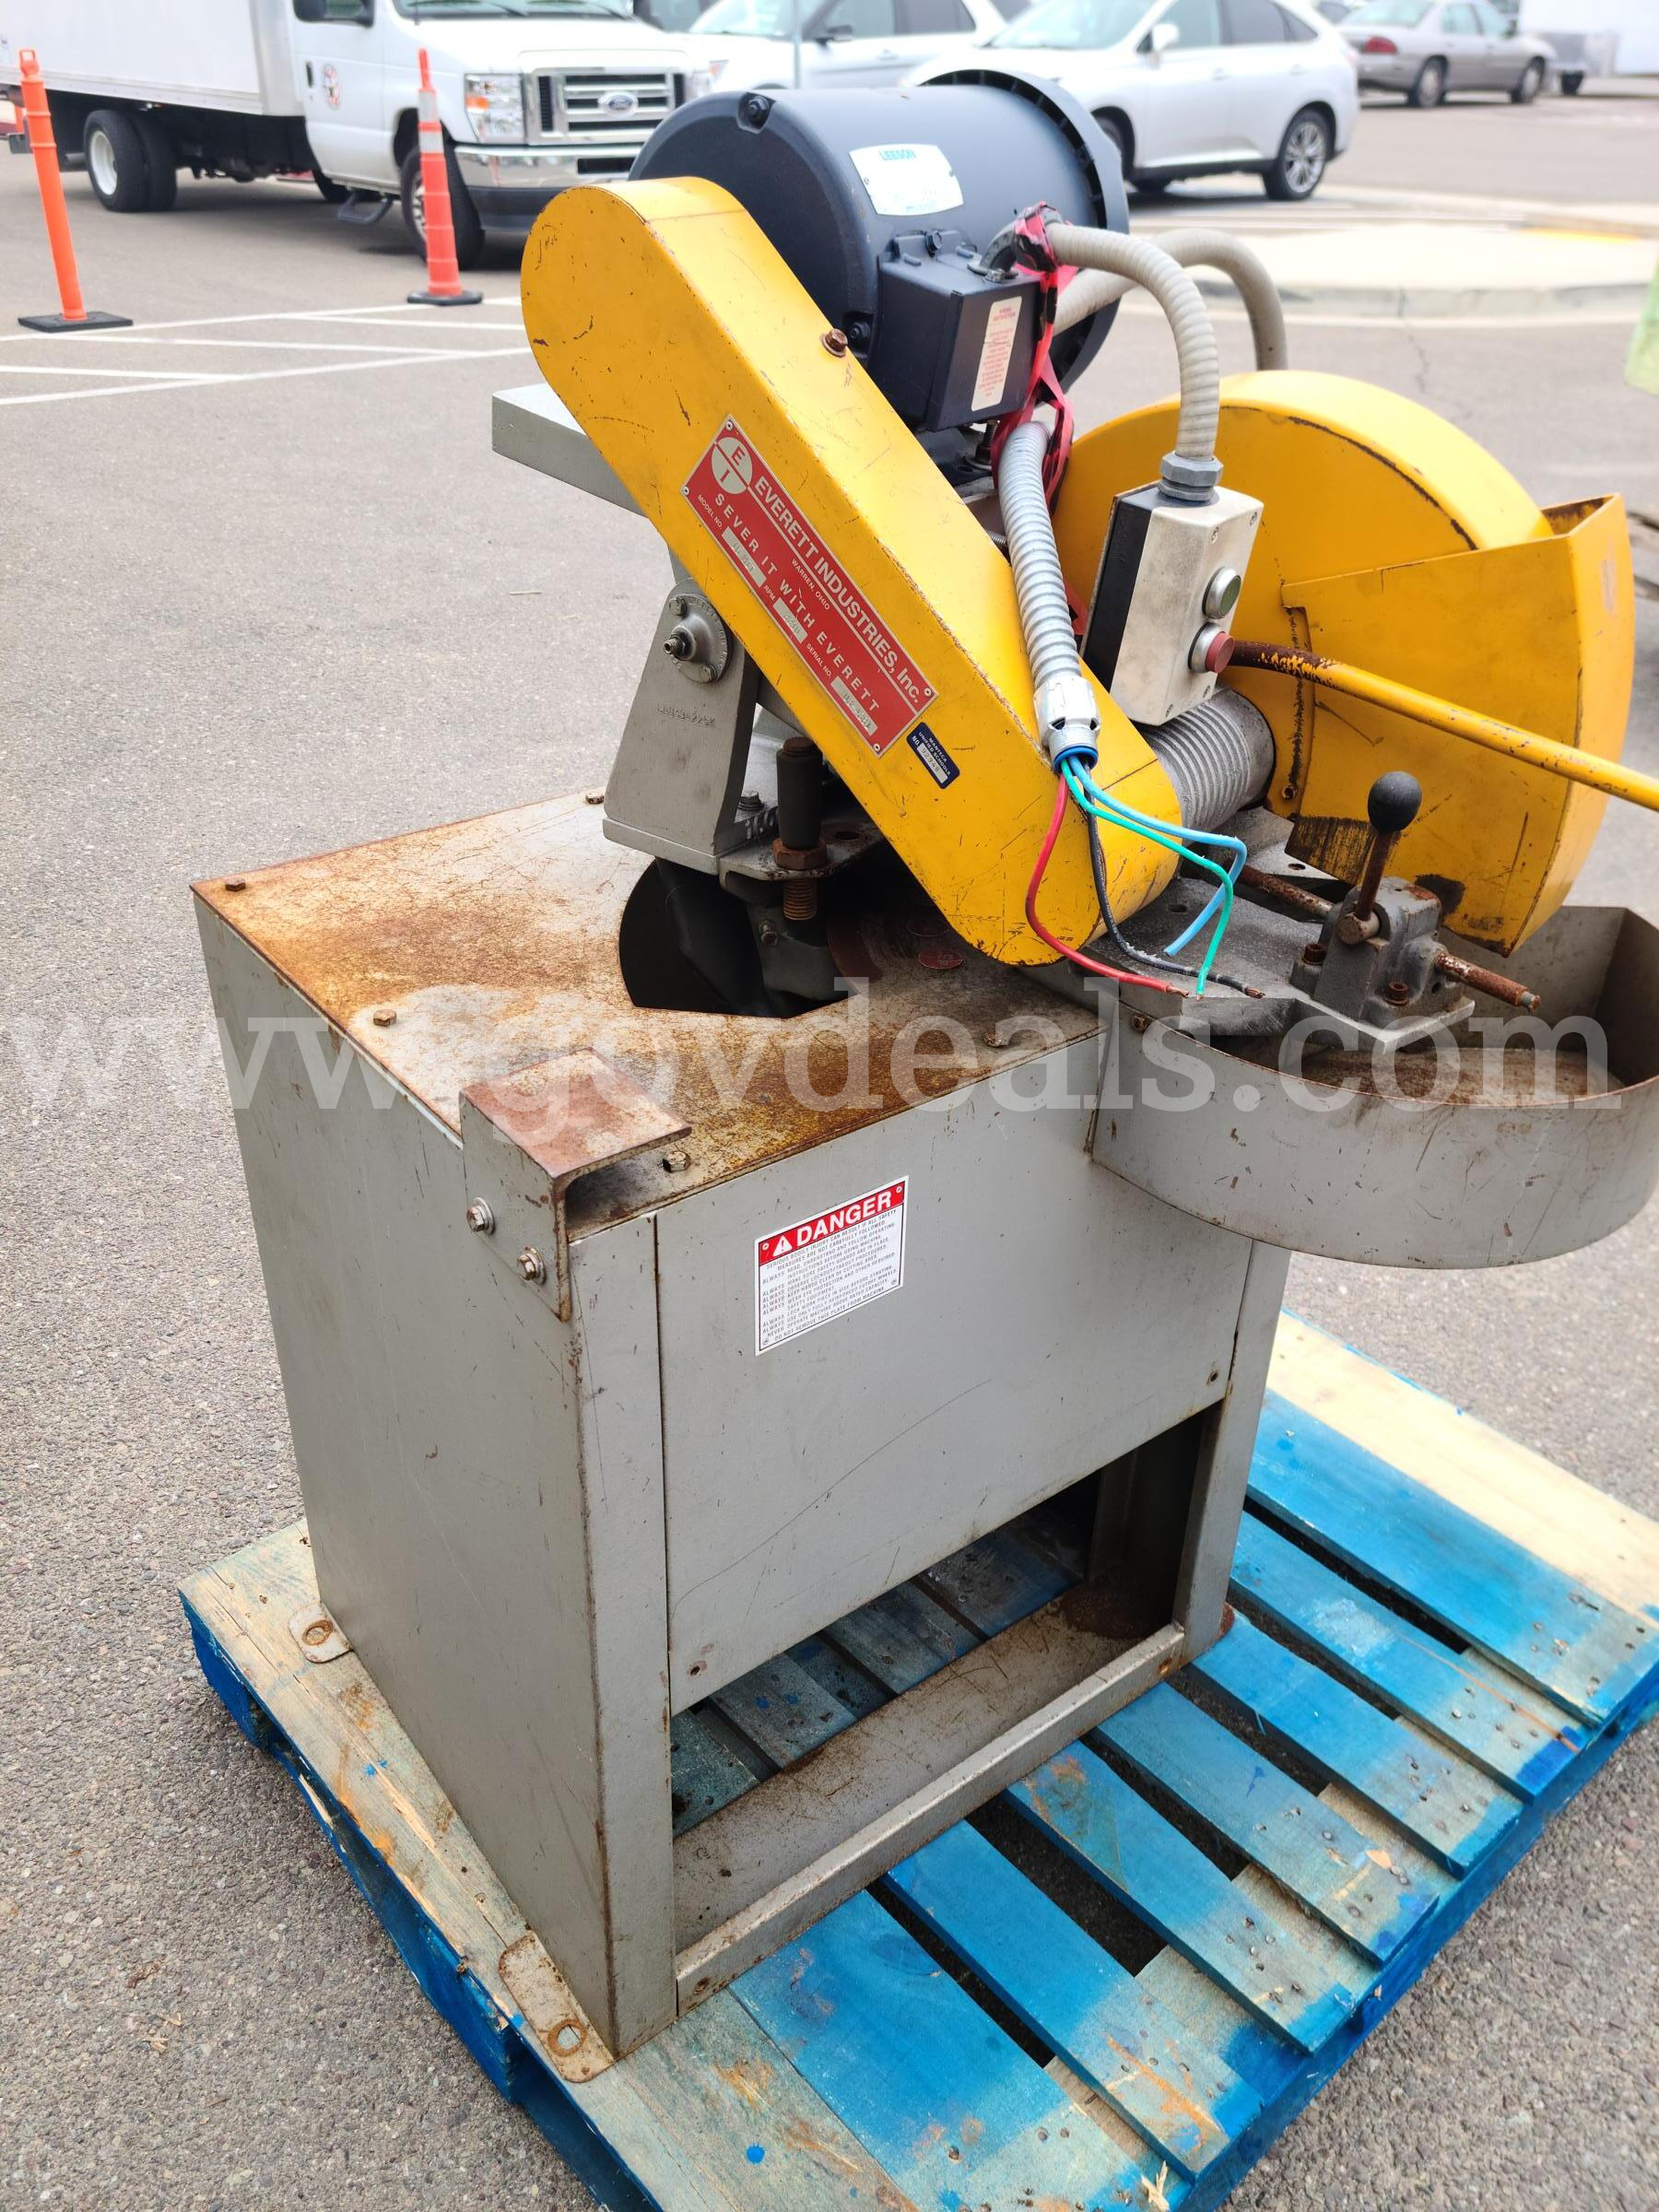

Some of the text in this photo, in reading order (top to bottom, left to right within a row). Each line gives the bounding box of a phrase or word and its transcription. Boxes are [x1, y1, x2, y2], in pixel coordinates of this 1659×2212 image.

[877, 148, 916, 161] LEESON
[730, 444, 746, 465] E
[719, 467, 730, 484] I
[697, 492, 715, 518] MODEL
[712, 513, 724, 530] NO.
[762, 583, 776, 602] RPM
[805, 641, 824, 666] SERIAL
[821, 664, 833, 679] NO.
[753, 474, 925, 704] EVERETT INDUSTRIES, Inc.
[790, 558, 830, 611] WARREN, OHIO
[713, 490, 879, 714] SEVER IT WITH EVERETT
[918, 731, 951, 775] UNIFIED SCHOOLS
[928, 736, 947, 762] MANTECA
[796, 1189, 891, 1246] DANGER
[878, 1208, 896, 1220] SAFETY
[818, 1244, 827, 1253] NOT
[762, 1269, 784, 1284] ALWAYS
[762, 1282, 784, 1297] ALWAYS
[762, 1288, 784, 1303] ALWAYS
[762, 1295, 784, 1309] ALWAYS
[762, 1300, 784, 1315] ALWAYS
[762, 1313, 784, 1327] ALWAYS
[762, 1319, 783, 1334] ALWAYS
